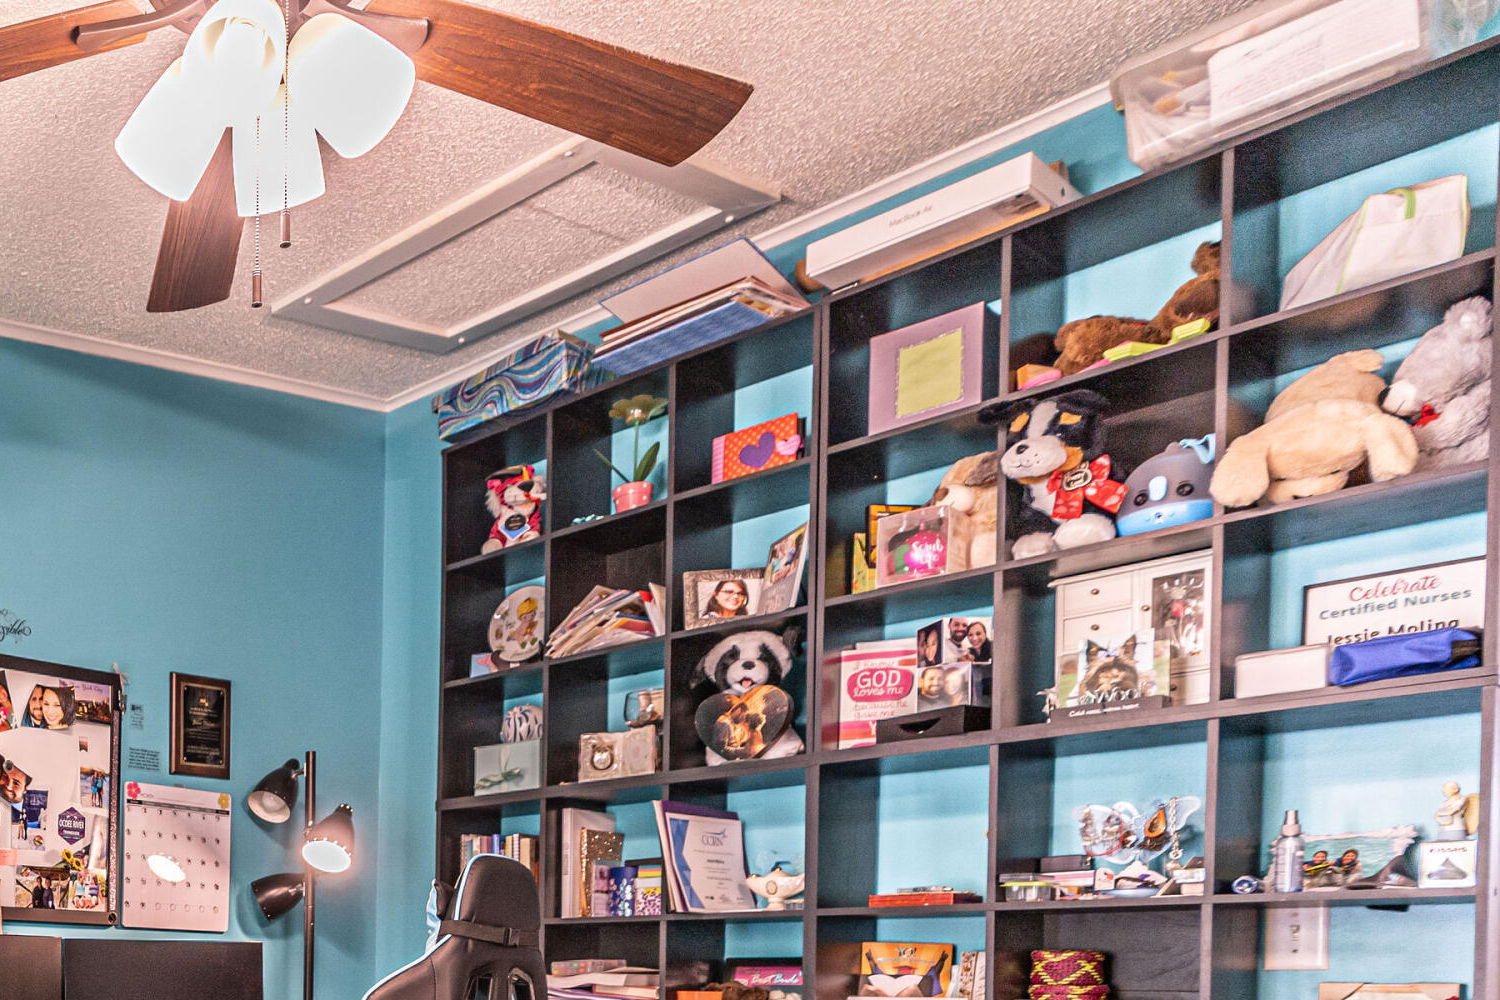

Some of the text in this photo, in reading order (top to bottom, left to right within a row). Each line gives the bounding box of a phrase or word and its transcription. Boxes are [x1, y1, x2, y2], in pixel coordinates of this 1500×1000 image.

[1349, 575, 1441, 602] Celebrate
[1319, 588, 1472, 620] Certified Nurses
[857, 670, 901, 689] GOD
[853, 687, 885, 698] loves
[896, 947, 917, 957] YO!
